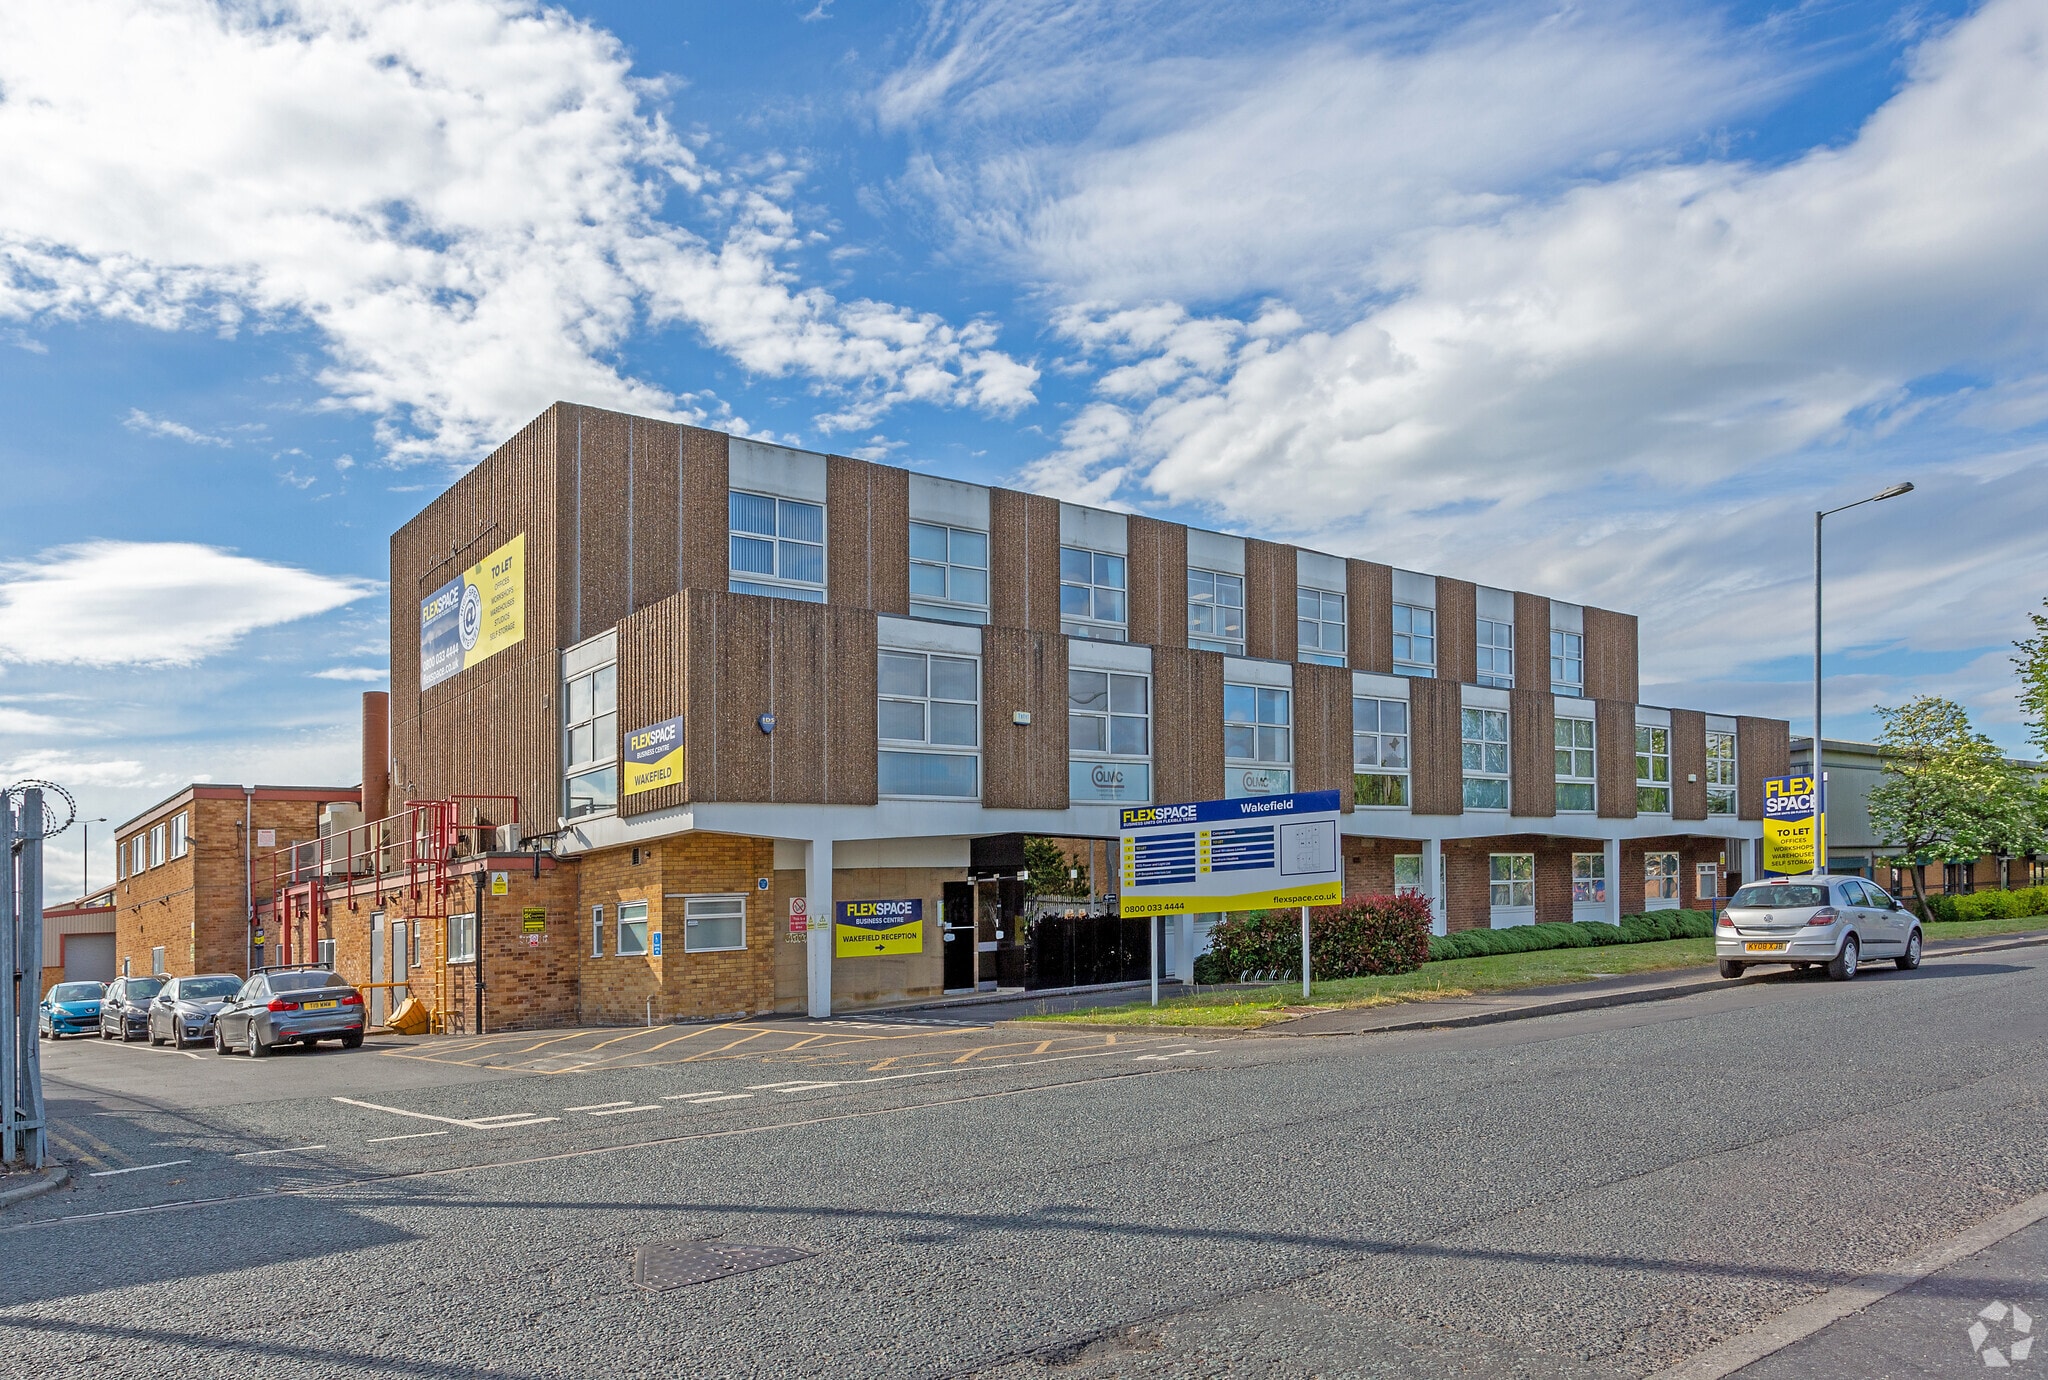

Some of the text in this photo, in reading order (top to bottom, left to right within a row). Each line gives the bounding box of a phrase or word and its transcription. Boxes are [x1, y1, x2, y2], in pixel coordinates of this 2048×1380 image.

[492, 556, 512, 579] TO LET
[494, 576, 510, 590] OFFICES
[491, 586, 514, 604] WORKSHOPS
[423, 586, 458, 623] FLEXSPACE
[490, 597, 514, 616] WAREHOUSES
[494, 612, 510, 627] STUDIOS
[490, 621, 515, 641] SELF STORAGE
[423, 642, 459, 672] 0800 033 4444
[423, 657, 459, 684] flexspace.co.uk
[631, 724, 676, 752] FLEXSPACE
[636, 744, 670, 759] BUSINESS CENTRE
[634, 767, 672, 786] WAKEFIELD
[1766, 776, 1814, 798] FLEX
[1123, 805, 1197, 822] FLEXSPACE
[1240, 799, 1294, 813] Wakefield
[1793, 828, 1810, 836] LET
[1273, 893, 1336, 903] flexspace.co.uk
[847, 902, 912, 916] FLEXSPACE
